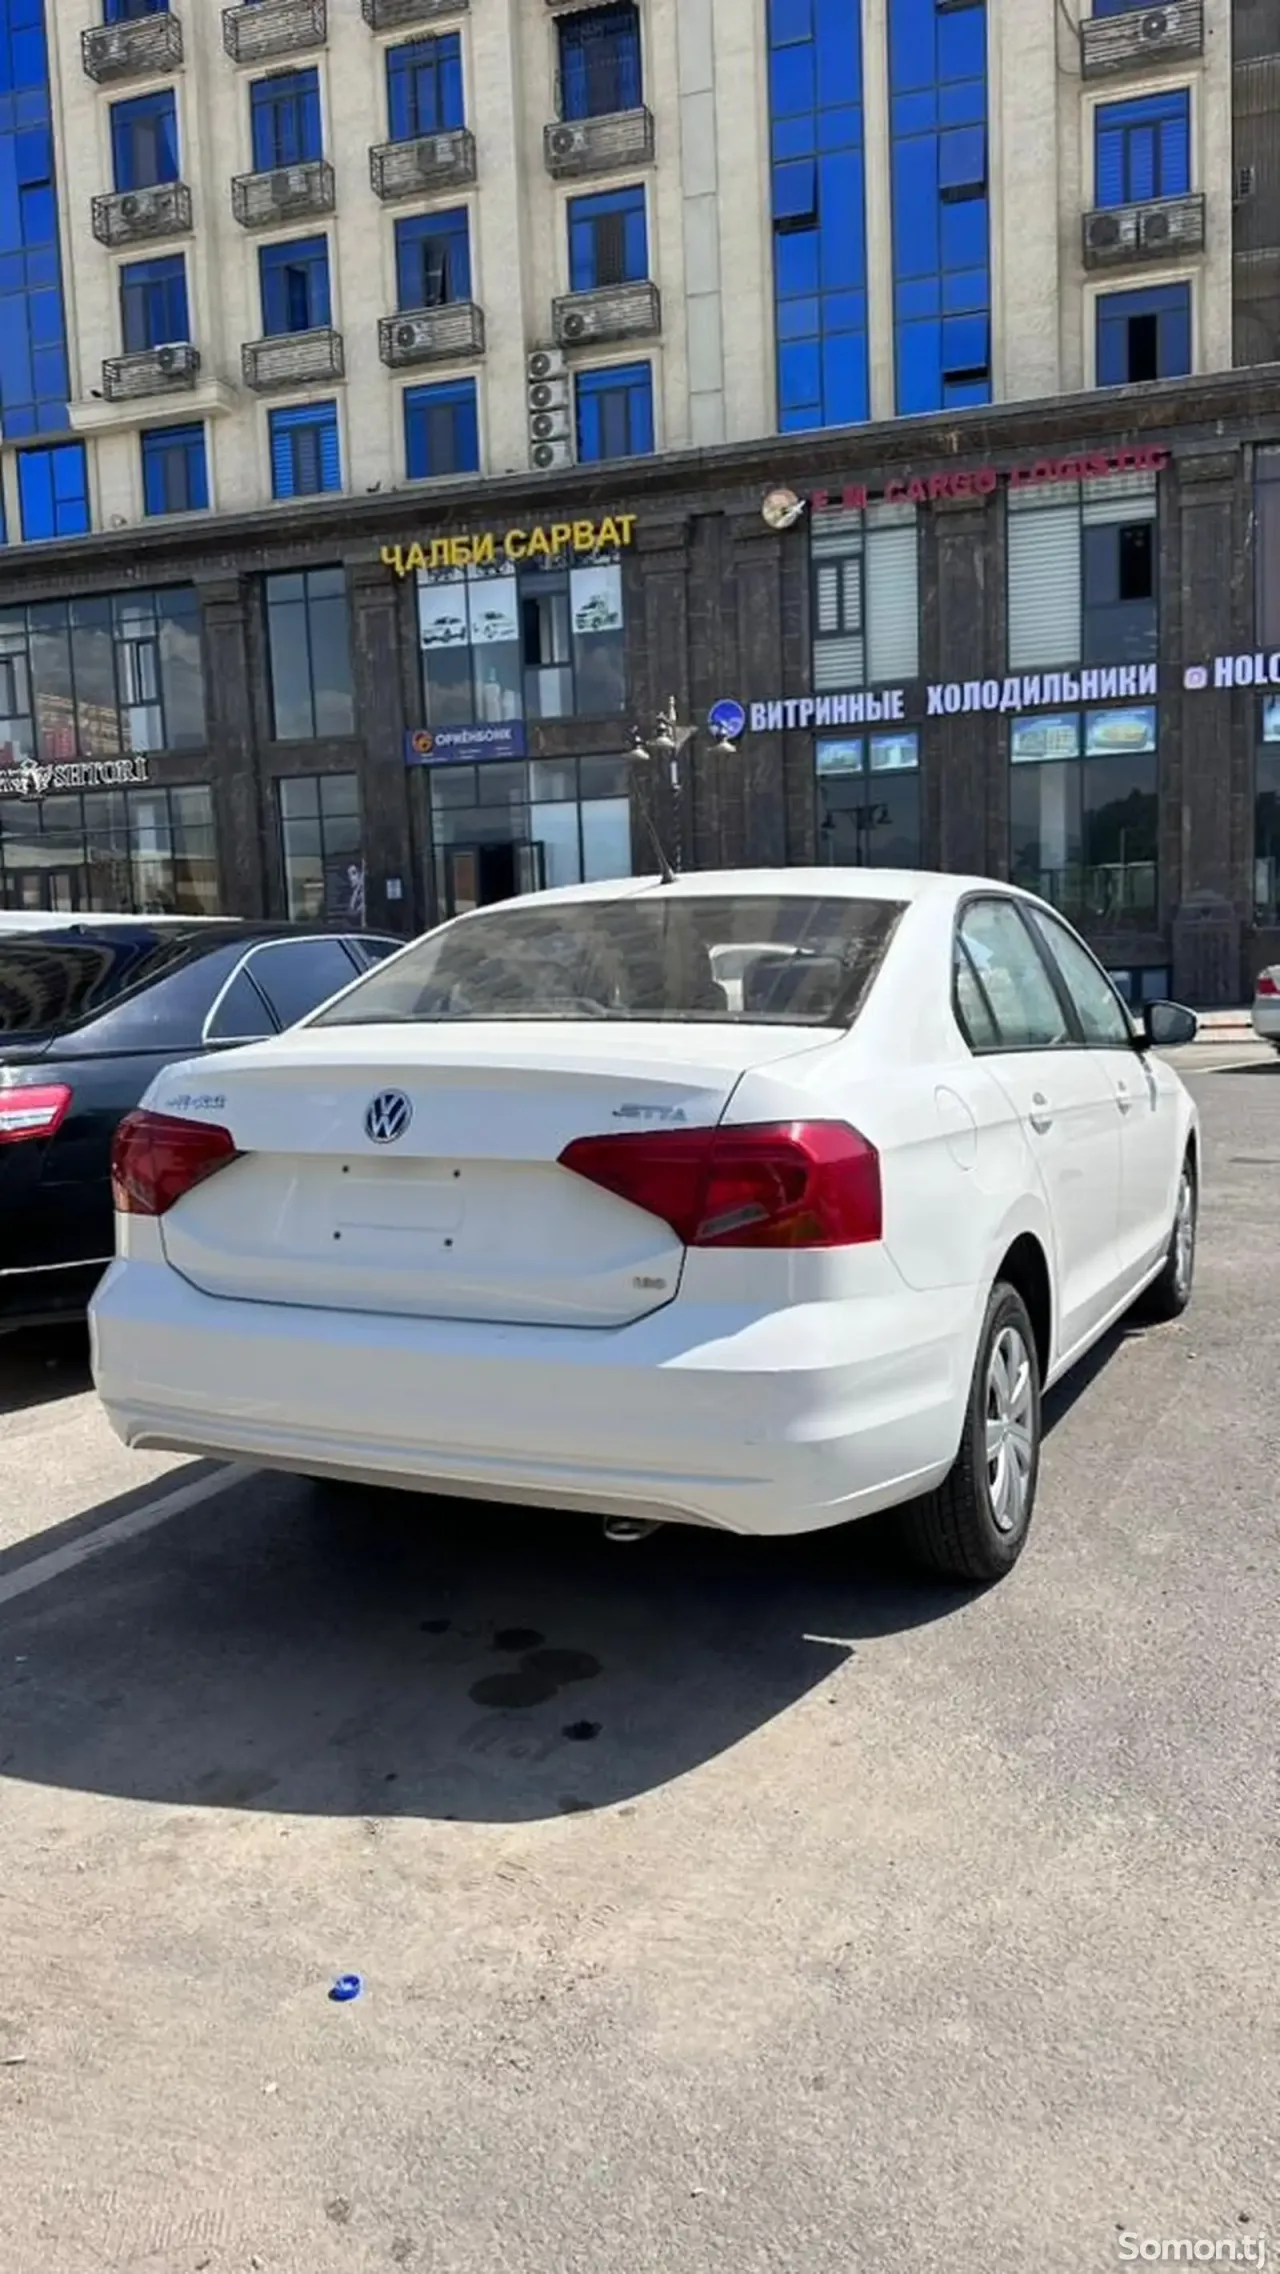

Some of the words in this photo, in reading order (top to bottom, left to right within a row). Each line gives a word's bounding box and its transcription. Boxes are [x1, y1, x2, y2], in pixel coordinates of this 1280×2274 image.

[884, 468, 997, 504] CARGO
[503, 514, 638, 561] САРВАТ
[750, 689, 905, 732] ВИТРИННЫЕ
[926, 663, 1158, 716] ХОЛОДИЛЬНИКИ
[611, 1103, 687, 1121] JETTA
